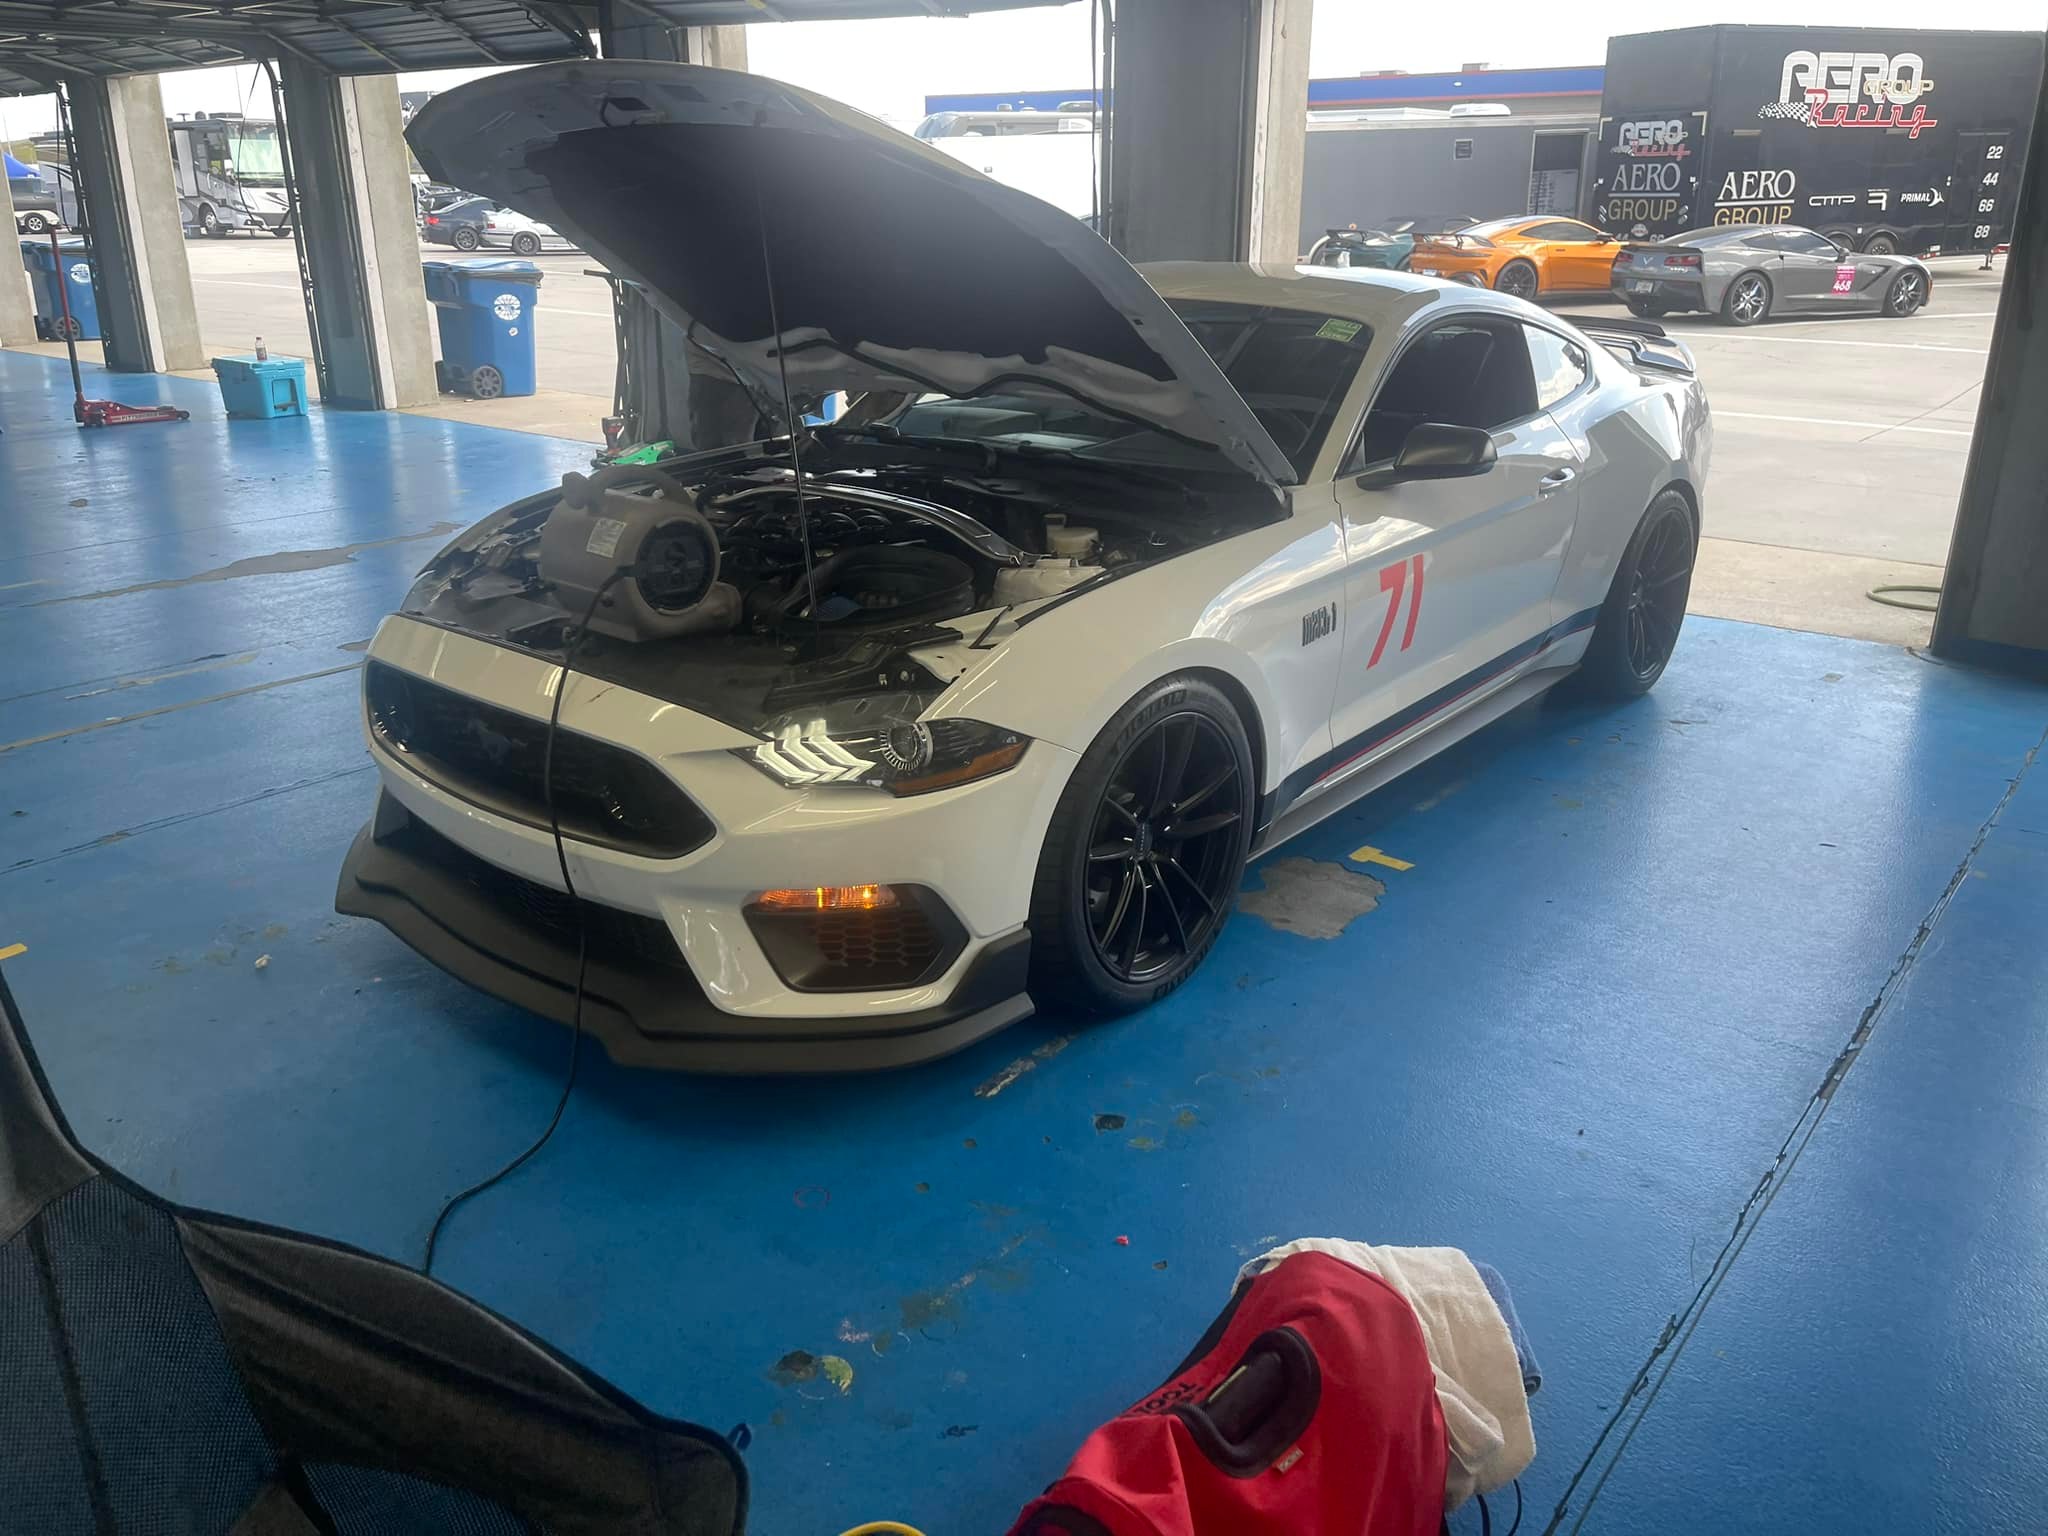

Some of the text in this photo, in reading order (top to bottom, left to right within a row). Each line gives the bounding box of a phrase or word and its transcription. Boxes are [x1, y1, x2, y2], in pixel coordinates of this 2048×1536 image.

[1779, 50, 1924, 105] AERO
[1804, 88, 1938, 139] Racing
[1986, 145, 2003, 159] 22
[1611, 163, 1681, 191] AERO
[1717, 169, 1796, 200] AERO
[1982, 172, 1999, 186] 44
[1900, 192, 1931, 203] PRIMAL
[1978, 199, 1995, 212] 66
[1607, 199, 1677, 221] GROUP
[1714, 205, 1792, 227] GROUP
[1974, 225, 1991, 238] 88
[1833, 280, 1852, 291] 468
[1366, 554, 1424, 671] 71
